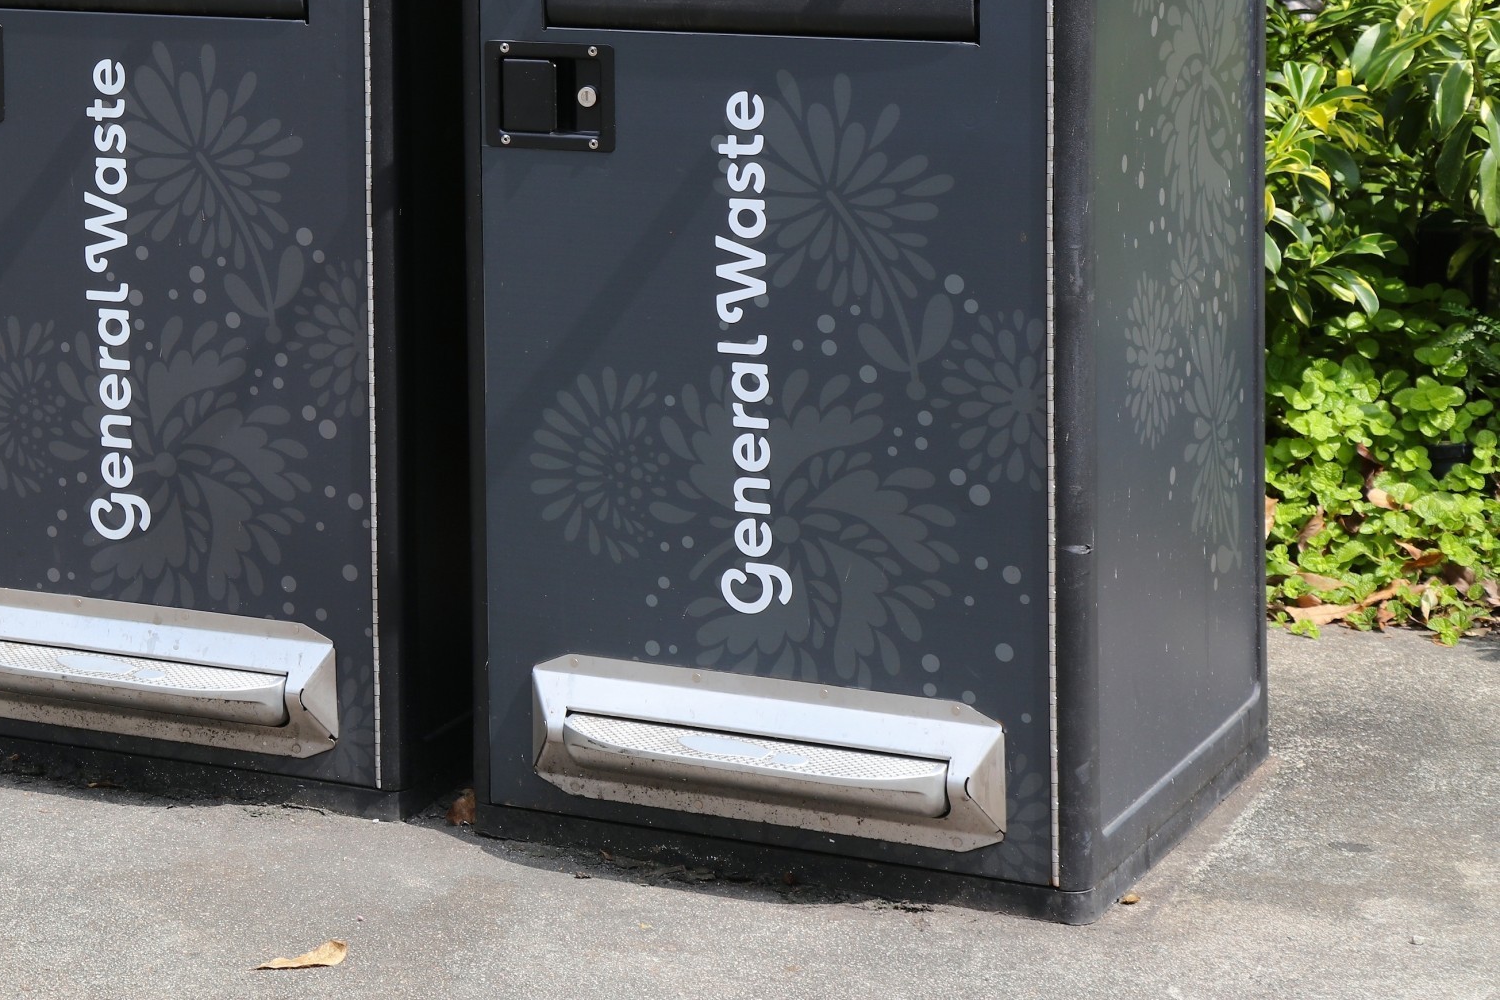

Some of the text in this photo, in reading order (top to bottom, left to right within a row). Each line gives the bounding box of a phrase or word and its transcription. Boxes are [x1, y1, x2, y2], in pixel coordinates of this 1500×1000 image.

[83, 58, 151, 540] General Waste
[715, 90, 793, 614] General Waste
